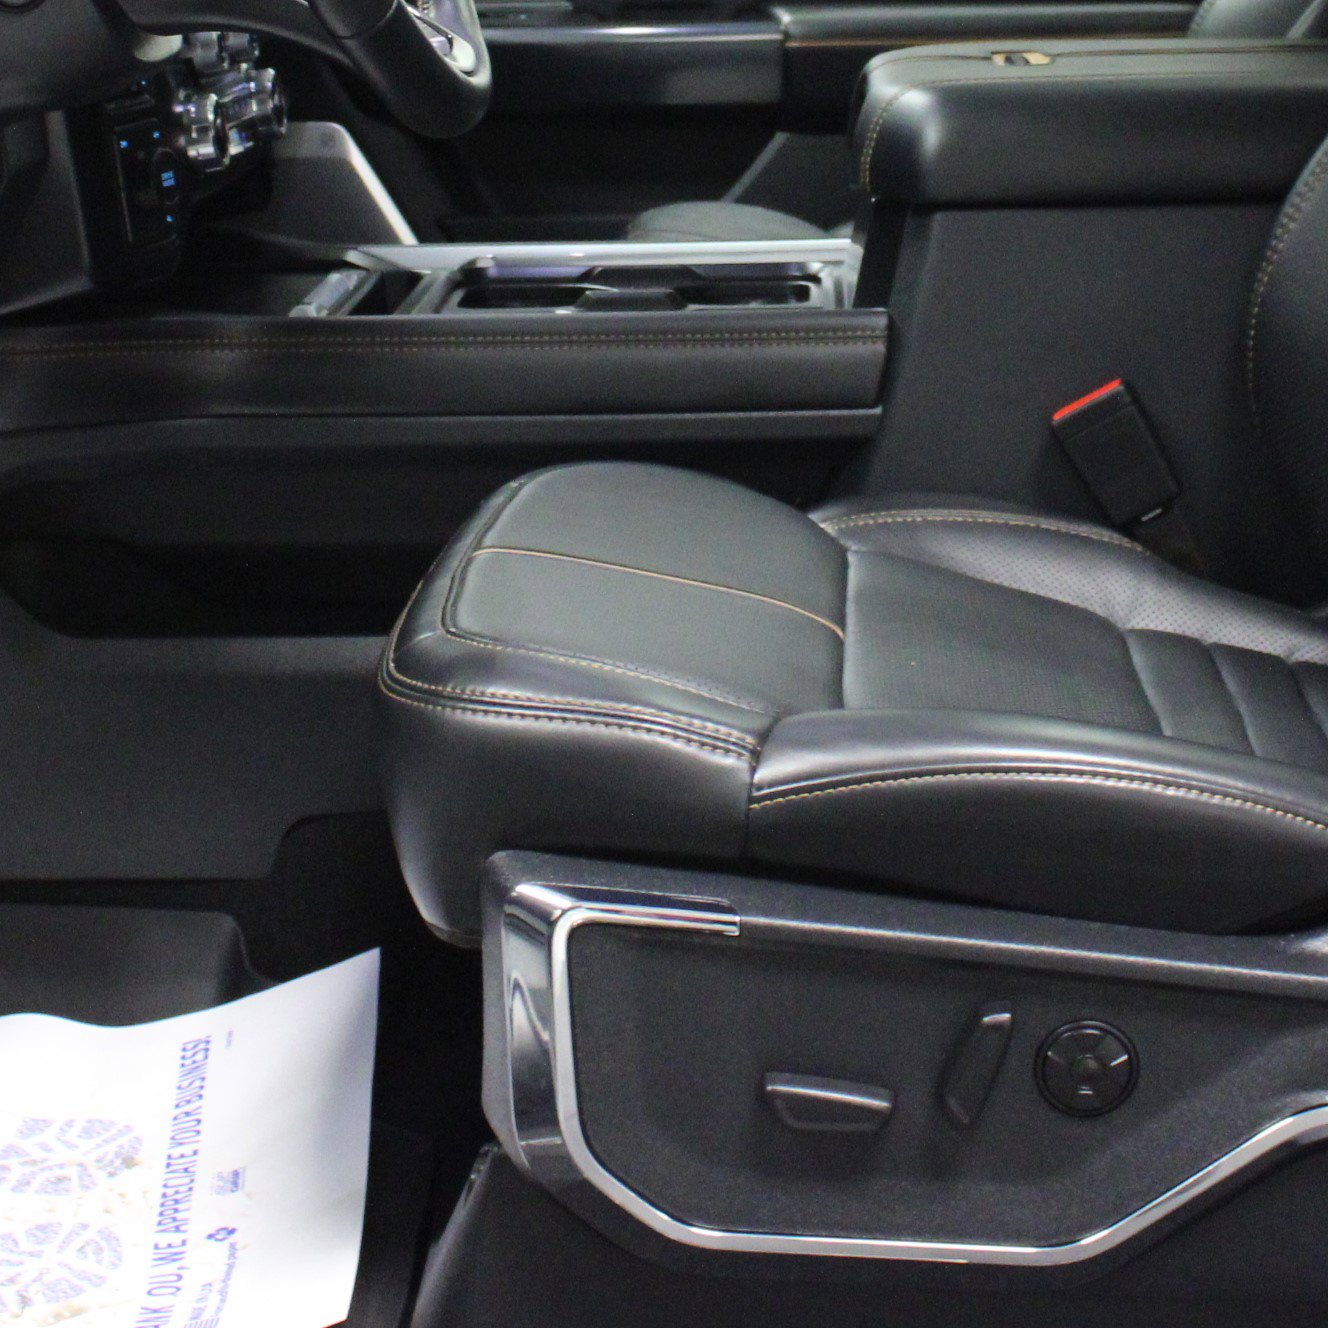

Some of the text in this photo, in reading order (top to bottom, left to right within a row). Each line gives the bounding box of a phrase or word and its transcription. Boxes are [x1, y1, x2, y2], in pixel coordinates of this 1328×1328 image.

[174, 1035, 212, 1109] BUSINESS!
[167, 1105, 203, 1150] YOUR
[154, 1149, 199, 1234] APPRECIATE
[146, 1266, 190, 1297] OU,
